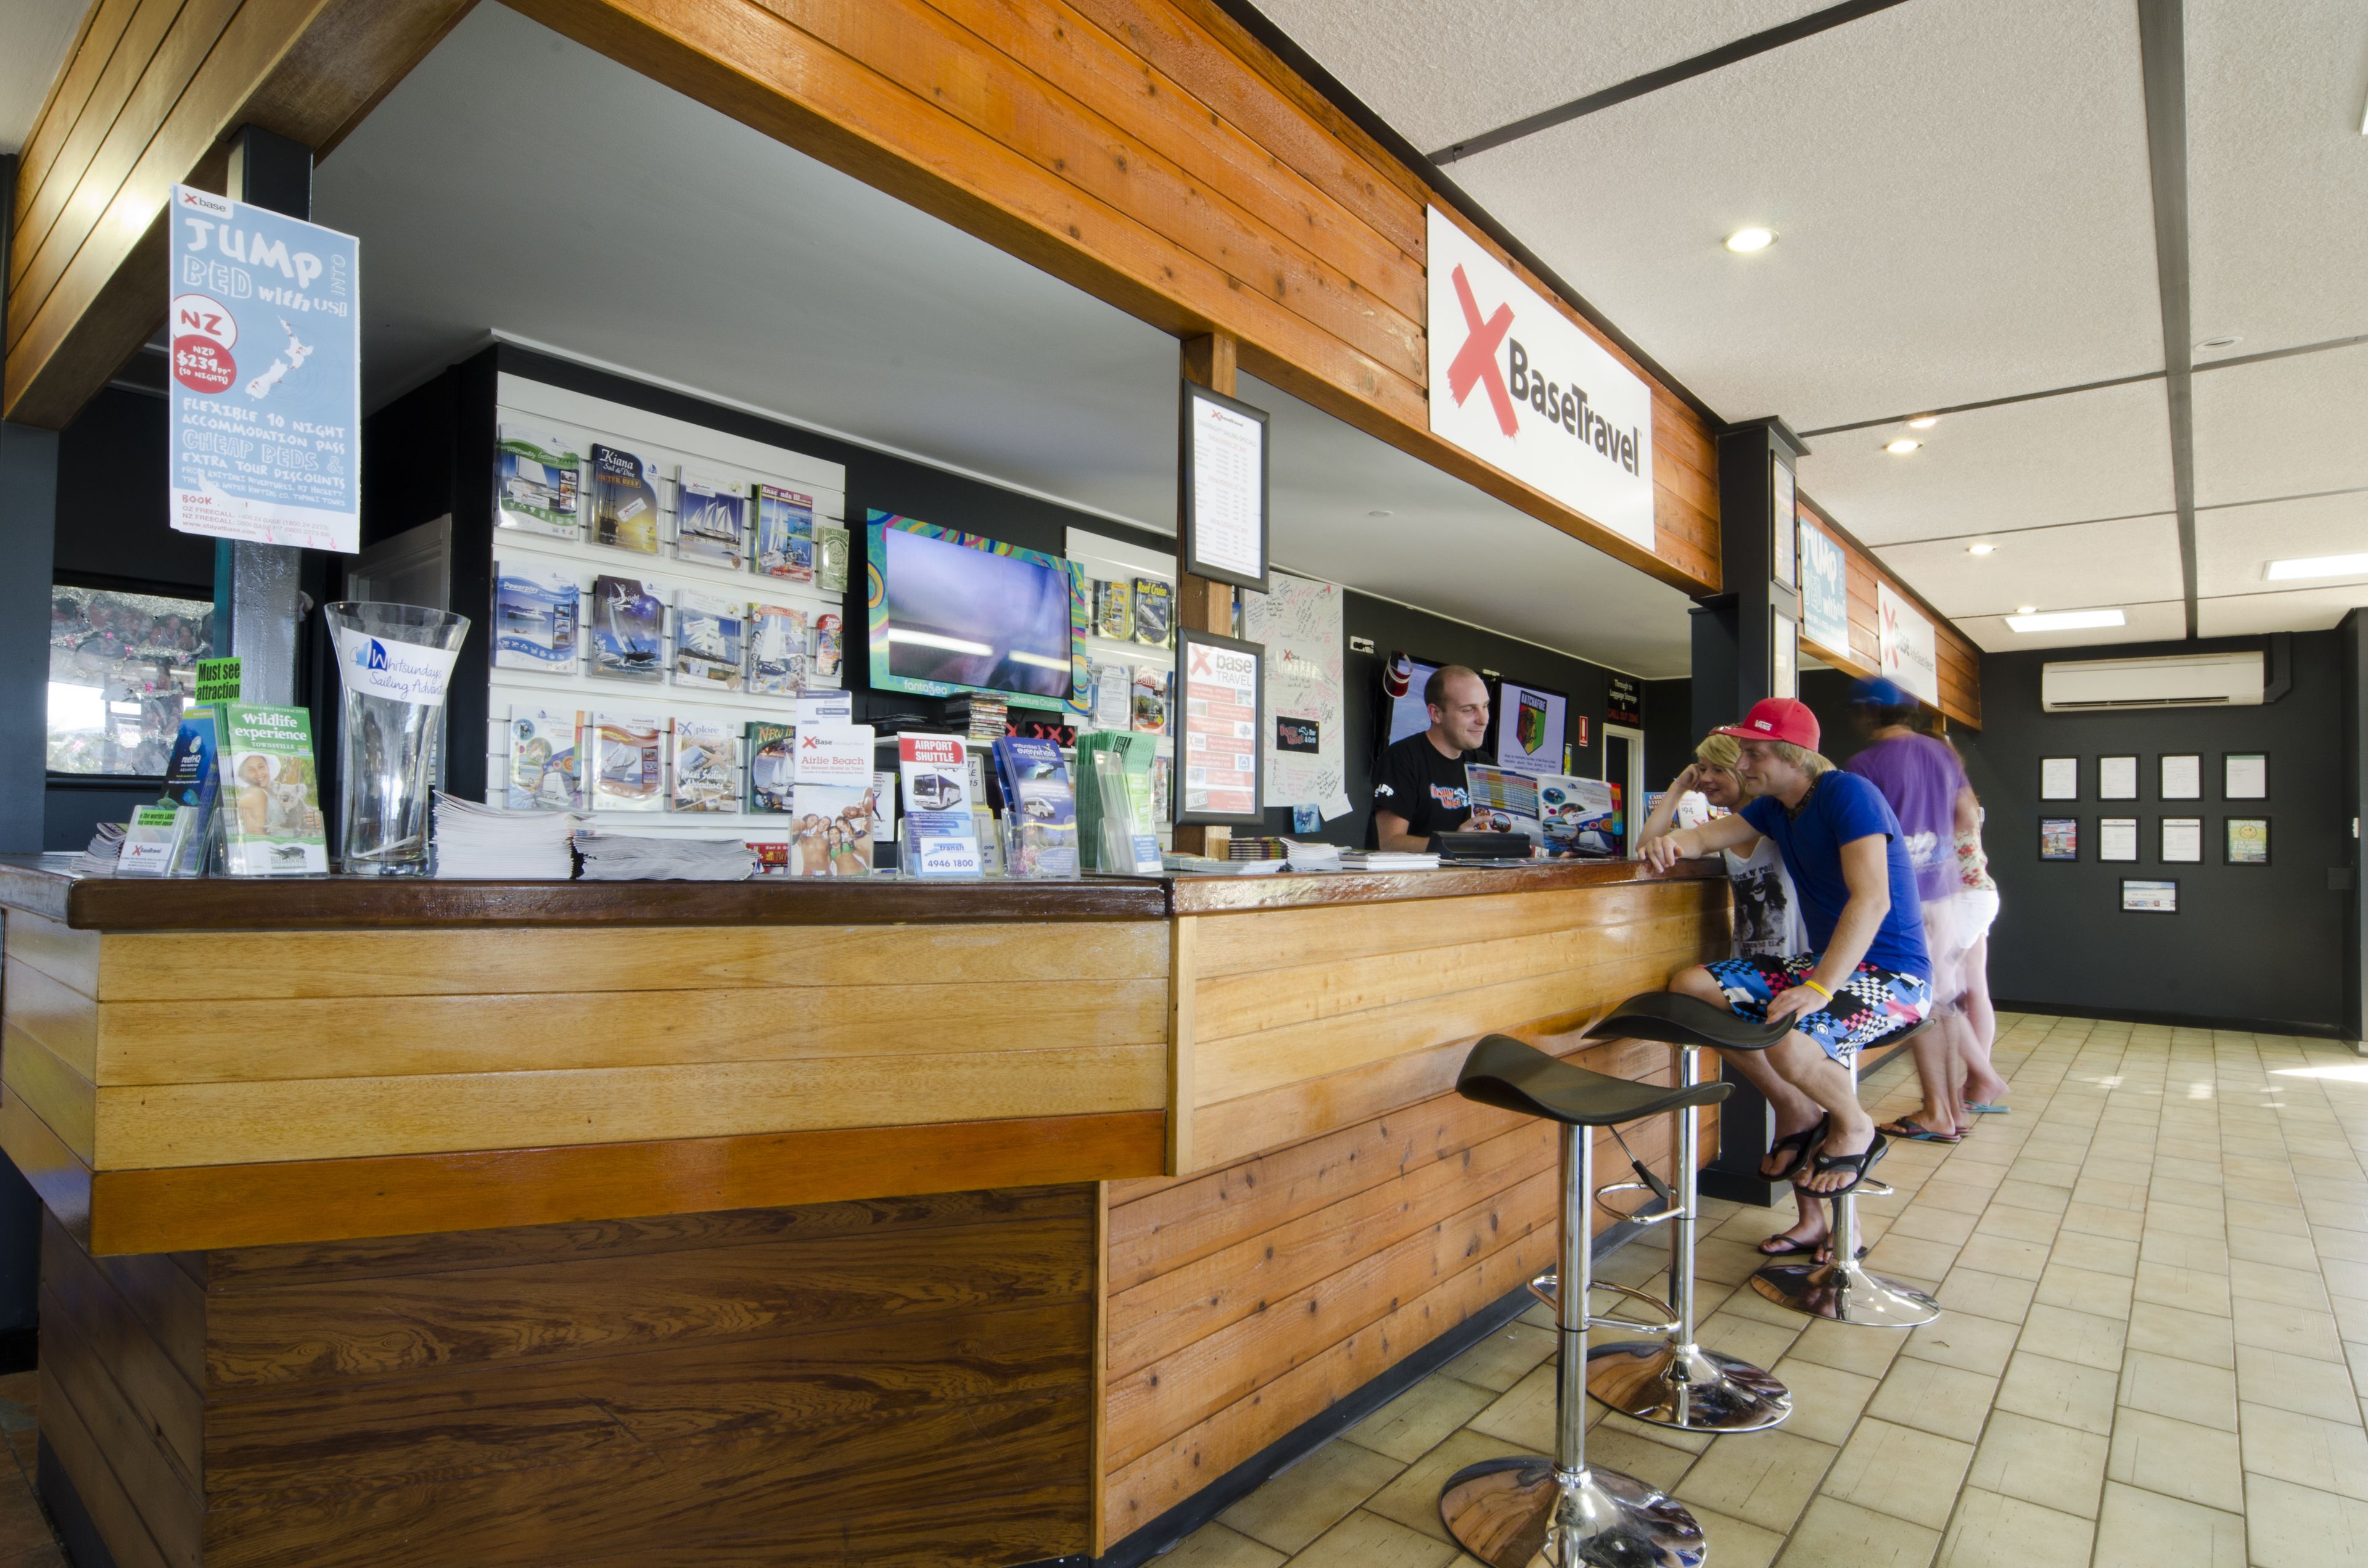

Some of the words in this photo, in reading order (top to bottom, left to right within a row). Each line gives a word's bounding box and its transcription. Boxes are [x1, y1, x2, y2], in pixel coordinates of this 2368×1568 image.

[199, 197, 226, 213] base
[185, 218, 323, 289] JUMP
[183, 253, 252, 299] BED
[331, 253, 347, 297] INTO
[258, 285, 311, 312] with
[181, 309, 223, 336] NZ
[192, 345, 215, 356] NZD
[176, 350, 218, 372] $239
[1510, 336, 1640, 478] BaseTravel
[183, 396, 258, 423] FLEXIBLE
[267, 413, 285, 428] 10
[292, 421, 345, 438] NIGHT
[182, 414, 308, 447] ACCOMMODATION
[315, 440, 345, 455] PASS
[183, 429, 254, 460] CHEAP
[261, 443, 319, 472] BEDS
[327, 456, 344, 475] &
[599, 448, 634, 470] Kiana
[182, 452, 228, 469] EXTRA
[235, 461, 268, 476] TOUR
[274, 468, 345, 490] DISCOUNTS
[181, 494, 212, 505] BOOK
[762, 485, 792, 500] Anacnda
[182, 520, 257, 536] www.stayatbase.com
[503, 581, 540, 594] Powerplay
[1137, 581, 1151, 594] Reef
[1151, 584, 1167, 597] Cruise
[372, 649, 443, 683] Whitsundays
[1216, 652, 1253, 674] base
[198, 662, 221, 683] Must
[223, 662, 241, 679] see
[1215, 670, 1252, 686] TRAVEL
[196, 681, 240, 701] attraction
[369, 671, 409, 700] Sailing
[1614, 679, 1629, 691] Through
[1040, 698, 1063, 710] Cruising
[1521, 692, 1546, 712] KATCHAFIRE
[1610, 688, 1625, 700] Luggage
[1624, 692, 1637, 704] Storage
[241, 712, 298, 728] Wildlife
[1755, 720, 1773, 731] VANS
[234, 727, 308, 741] experience
[251, 741, 295, 750] TOWNSVILLE
[915, 740, 953, 752] AIRPORT
[1017, 747, 1056, 757] everywhere
[801, 756, 829, 765] Airlie
[832, 757, 865, 765] Beach
[915, 751, 955, 762] SHUTTLE
[702, 770, 728, 781] Sailing
[684, 780, 724, 790] Adventures
[927, 860, 950, 868] 4946
[953, 859, 974, 867] 1800
